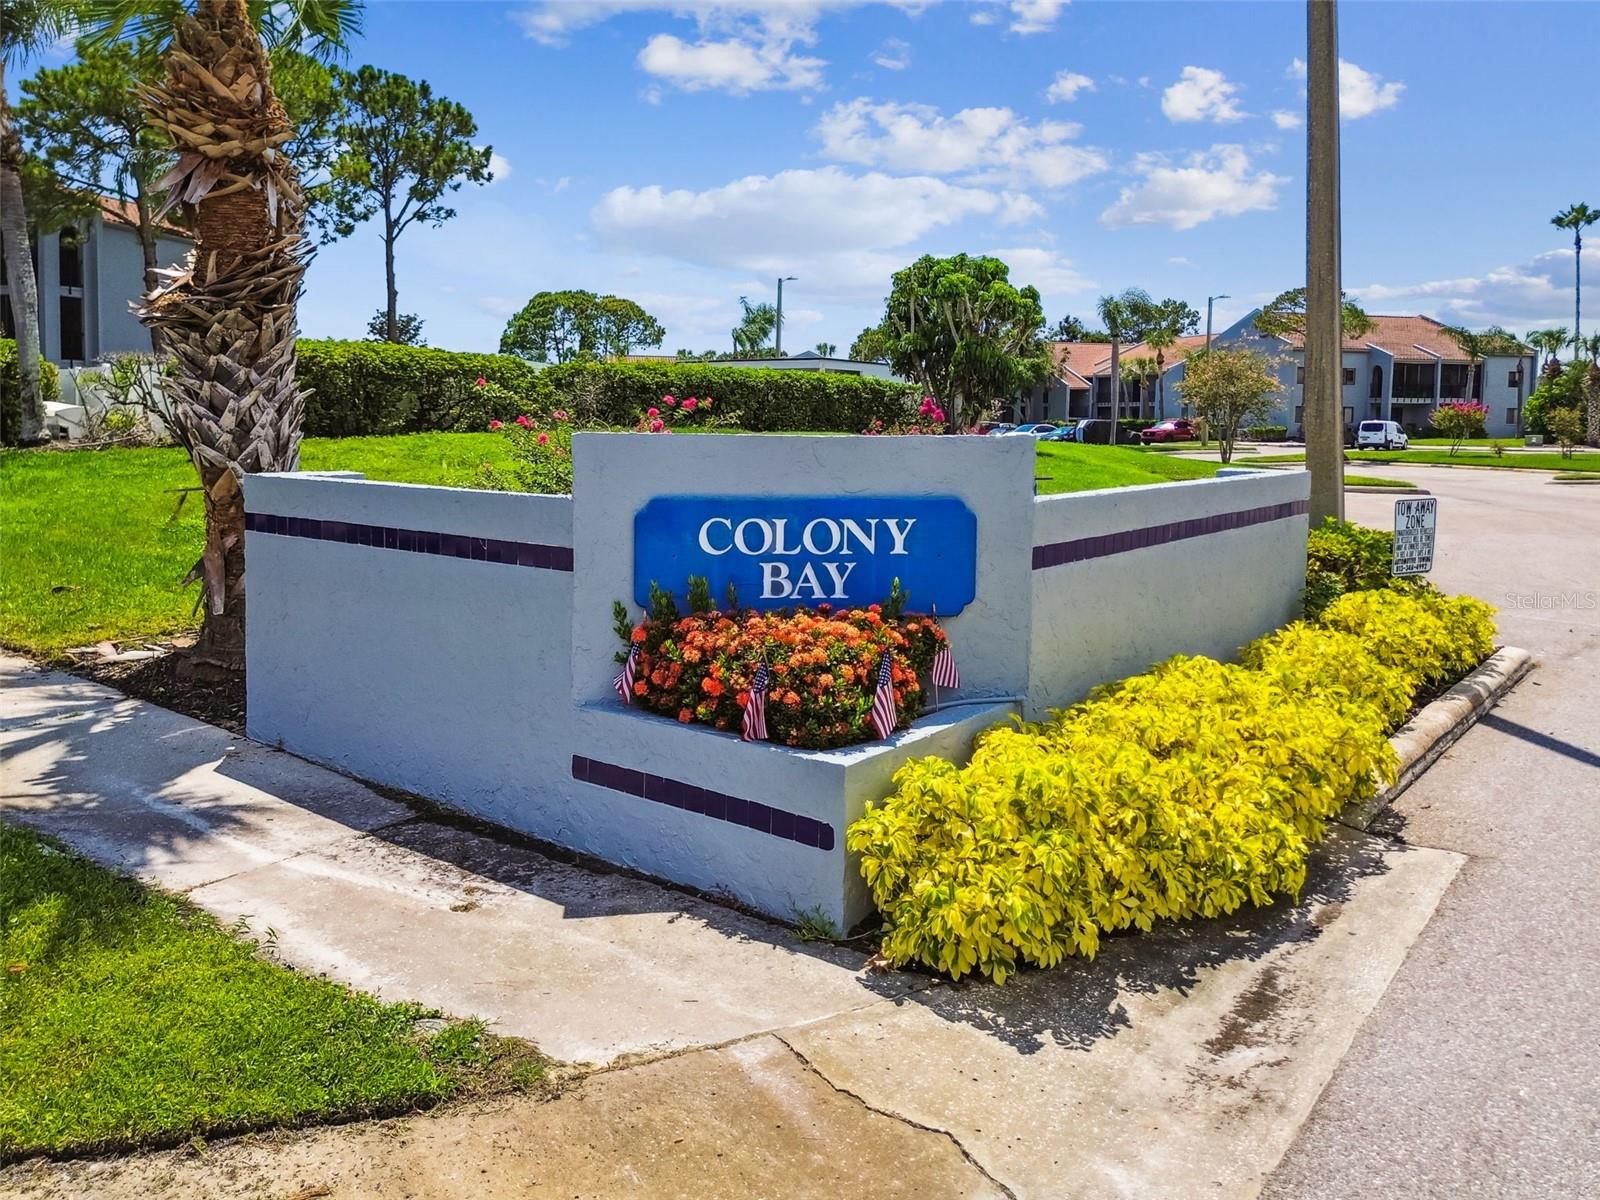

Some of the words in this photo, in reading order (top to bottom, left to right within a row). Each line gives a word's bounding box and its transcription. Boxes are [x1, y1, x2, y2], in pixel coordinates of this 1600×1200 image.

[1397, 502, 1412, 516] TOW
[1415, 501, 1434, 514] AWAY
[1405, 515, 1425, 528] ZONE
[698, 517, 917, 556] COLONY
[759, 562, 857, 599] BAY
